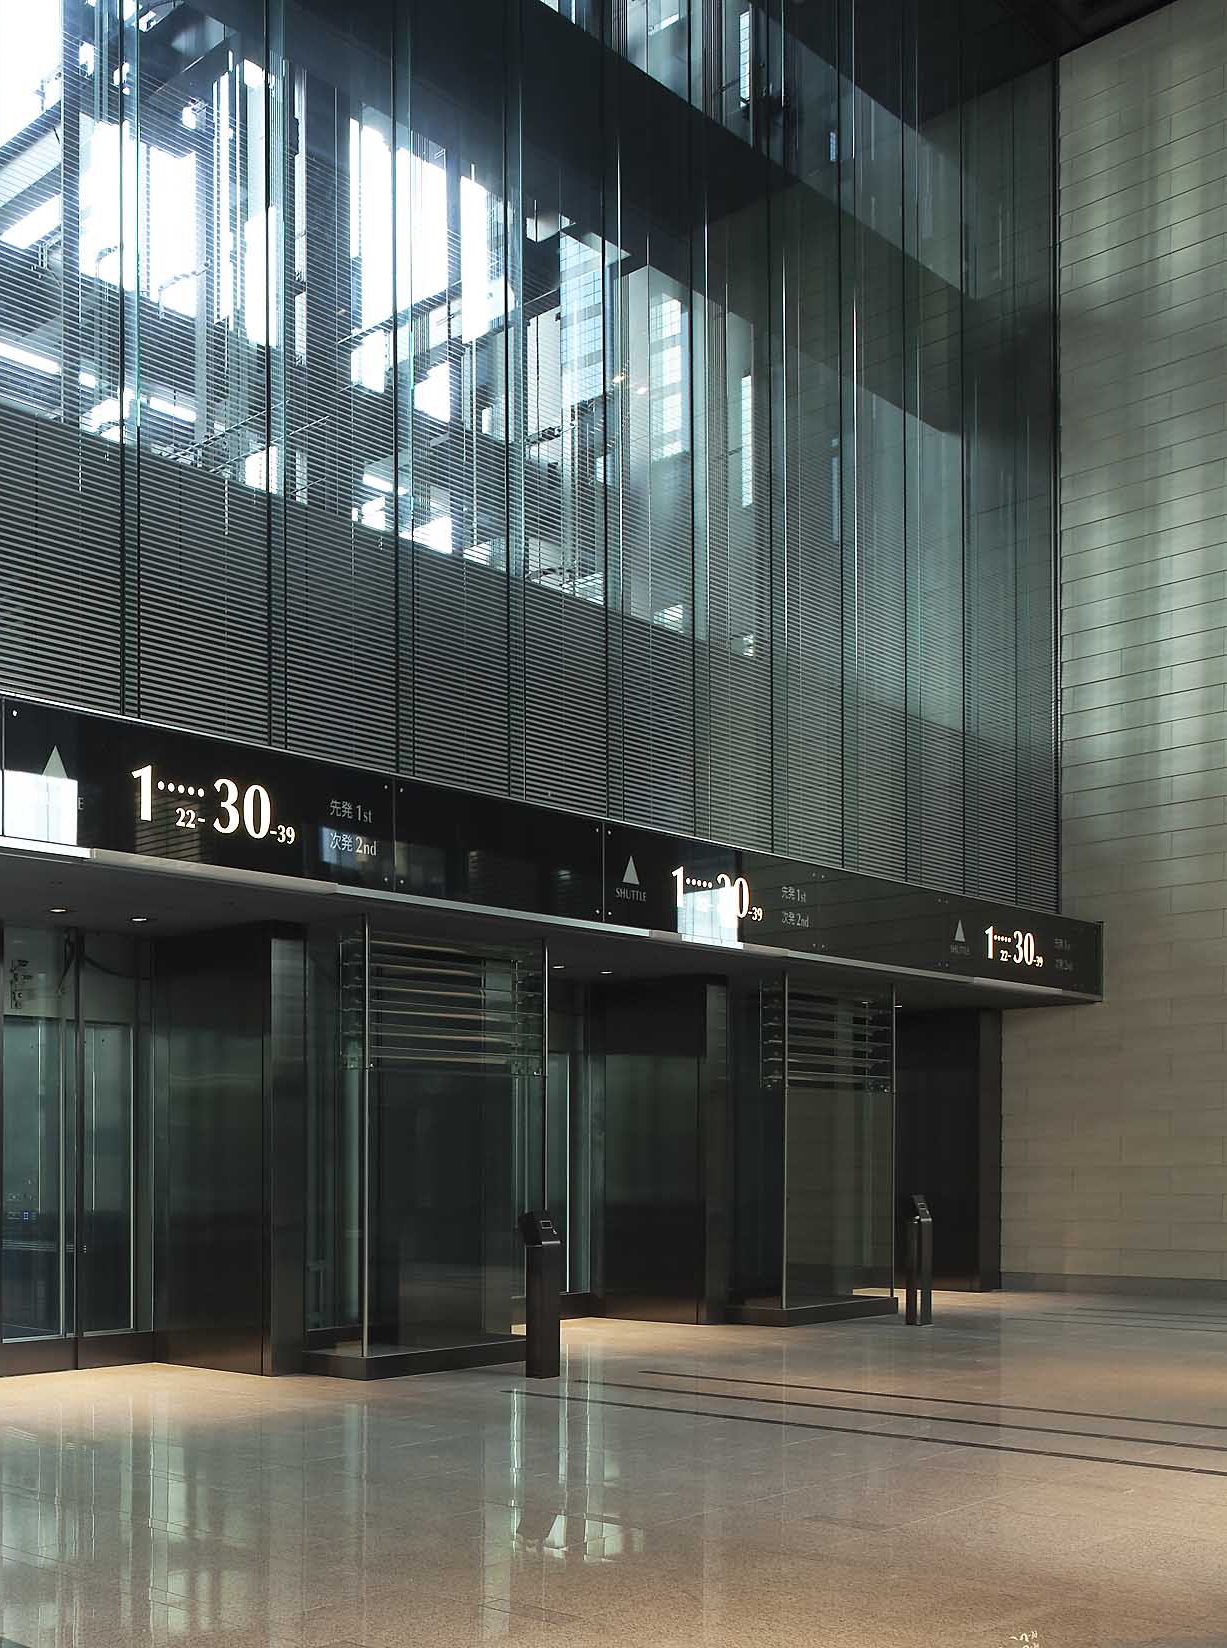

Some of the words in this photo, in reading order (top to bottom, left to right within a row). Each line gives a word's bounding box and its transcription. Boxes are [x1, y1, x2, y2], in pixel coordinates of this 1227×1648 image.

[213, 778, 272, 840] 30
[329, 799, 354, 819] 先発
[356, 804, 373, 824] 1st
[329, 832, 354, 853] 次発
[355, 837, 377, 857] 2nd
[615, 887, 647, 902] SHUTTLE
[1013, 930, 1035, 965] 30
